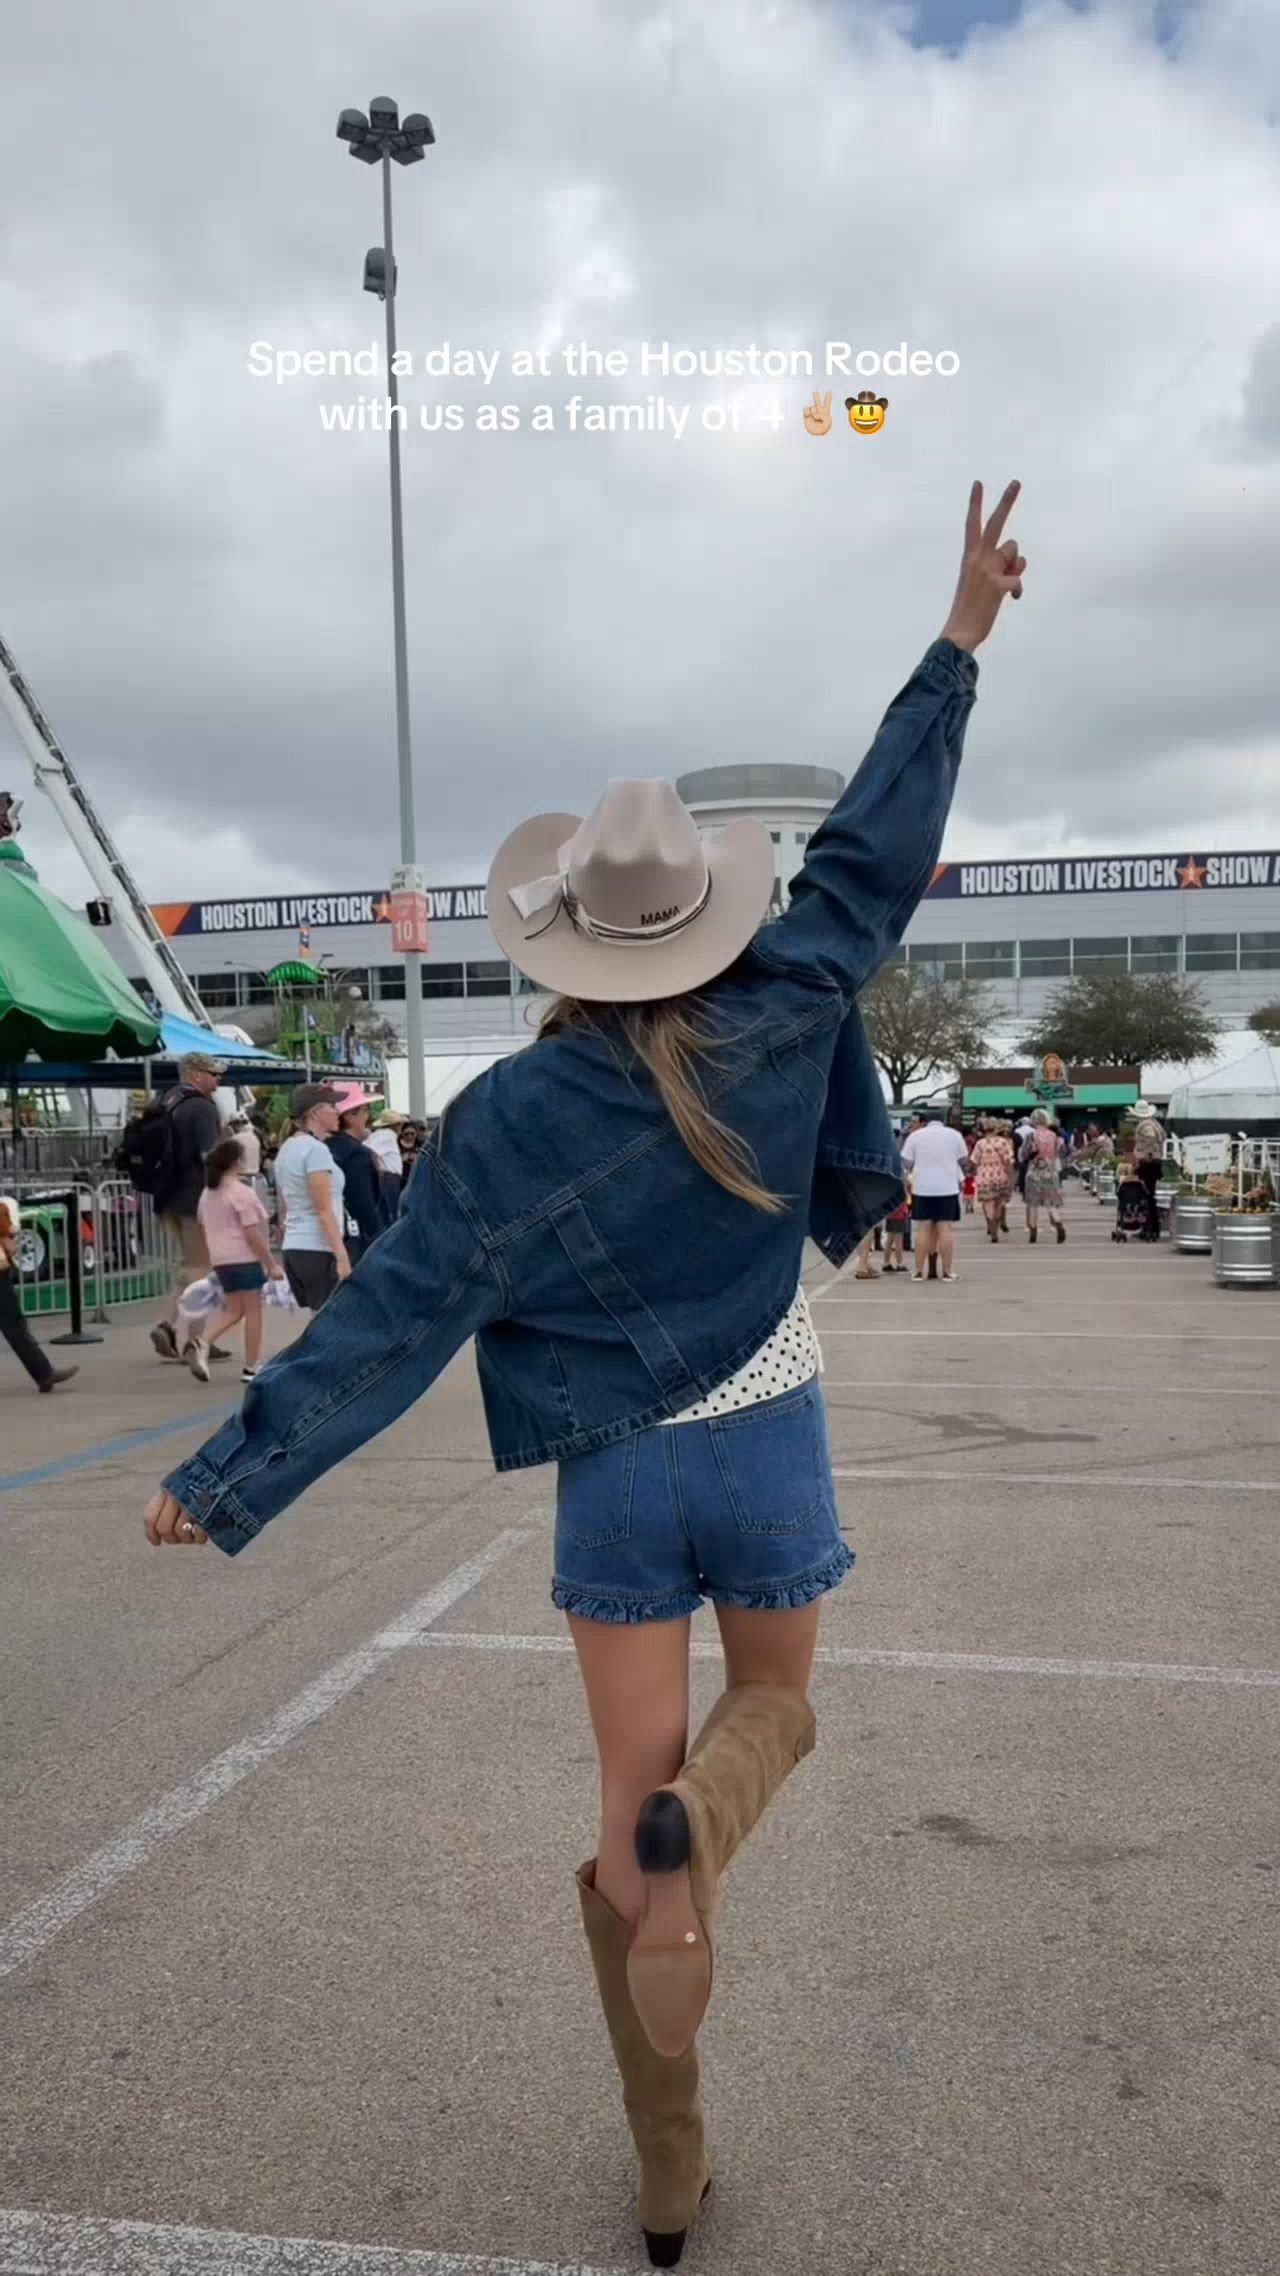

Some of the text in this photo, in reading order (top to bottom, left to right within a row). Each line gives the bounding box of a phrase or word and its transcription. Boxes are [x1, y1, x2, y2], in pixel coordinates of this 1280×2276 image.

[960, 863, 1060, 895] HOUSTON
[1065, 857, 1179, 891] LIVESTOCK
[1206, 856, 1270, 886] SHOW
[201, 901, 278, 931] HOUSTON
[281, 895, 374, 927] LIVESTOCK
[426, 891, 452, 918] OW
[640, 905, 680, 926] MAMA
[395, 921, 412, 941] 10
